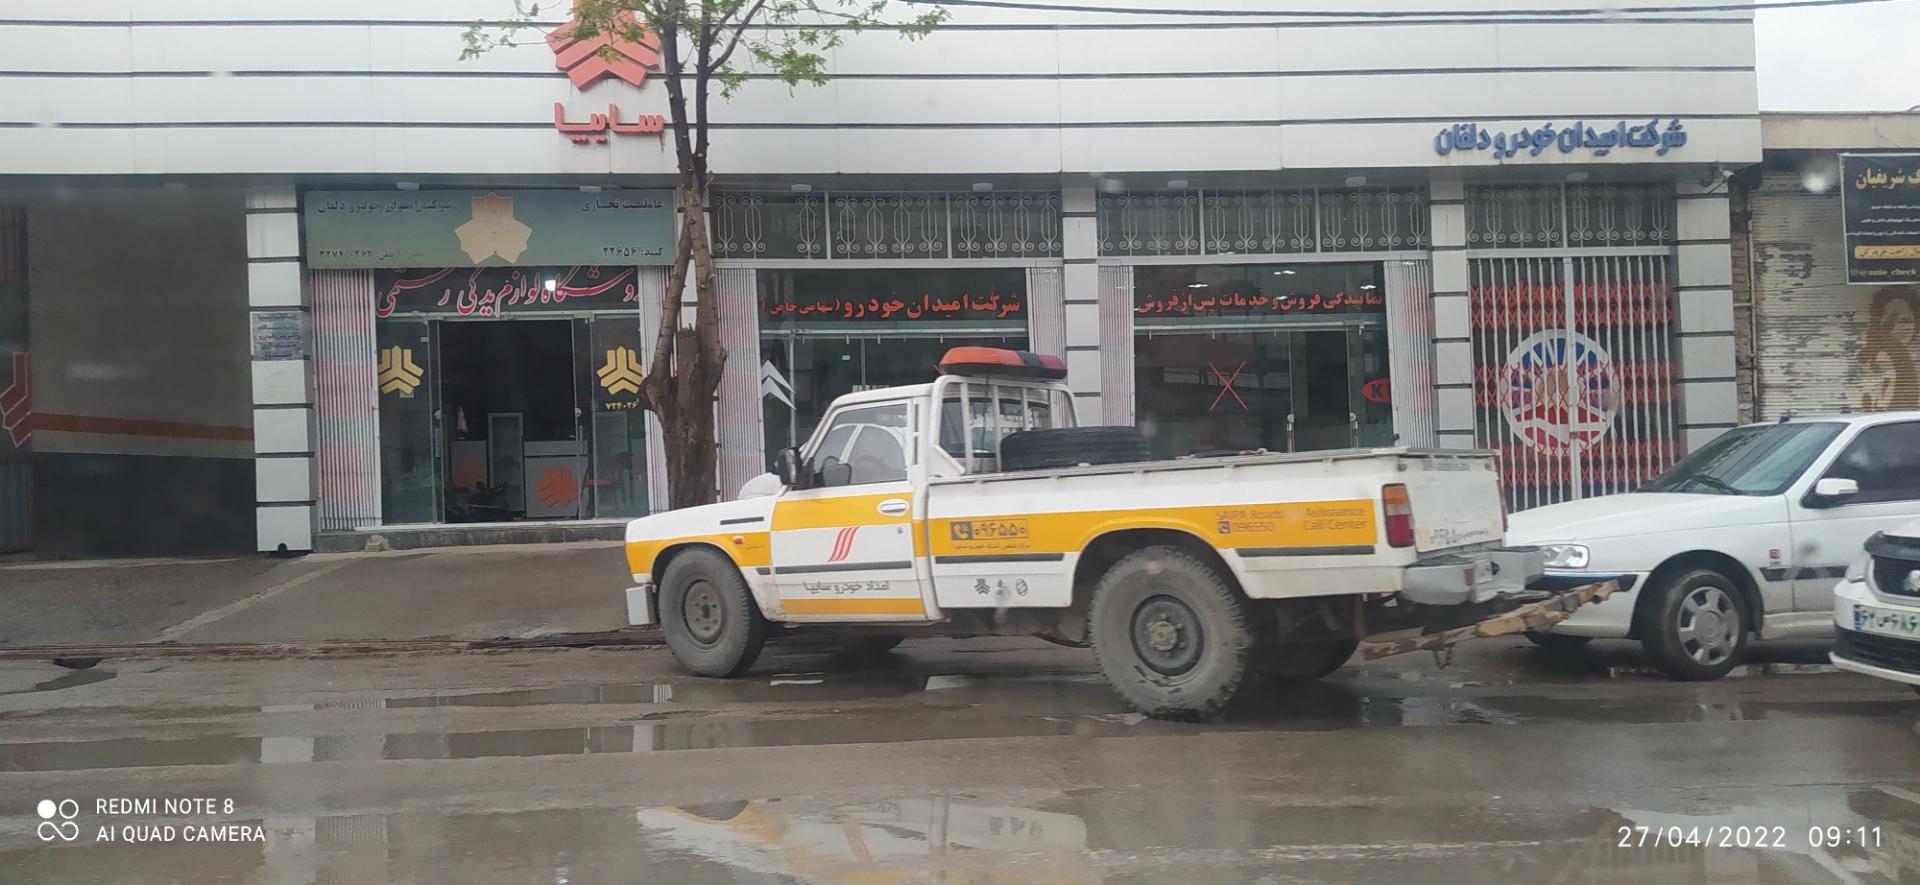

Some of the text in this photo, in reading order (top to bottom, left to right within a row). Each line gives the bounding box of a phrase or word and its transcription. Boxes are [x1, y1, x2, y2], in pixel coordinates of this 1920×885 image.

[554, 102, 665, 144] سایپا
[1434, 118, 1688, 159] شرکت امیدان خودرو دلفان
[1855, 168, 1906, 190] شریفیان
[495, 270, 541, 318] لوازم
[906, 292, 969, 318] امیدان
[972, 291, 1020, 318] شرکت
[1220, 290, 1268, 306] خدمات
